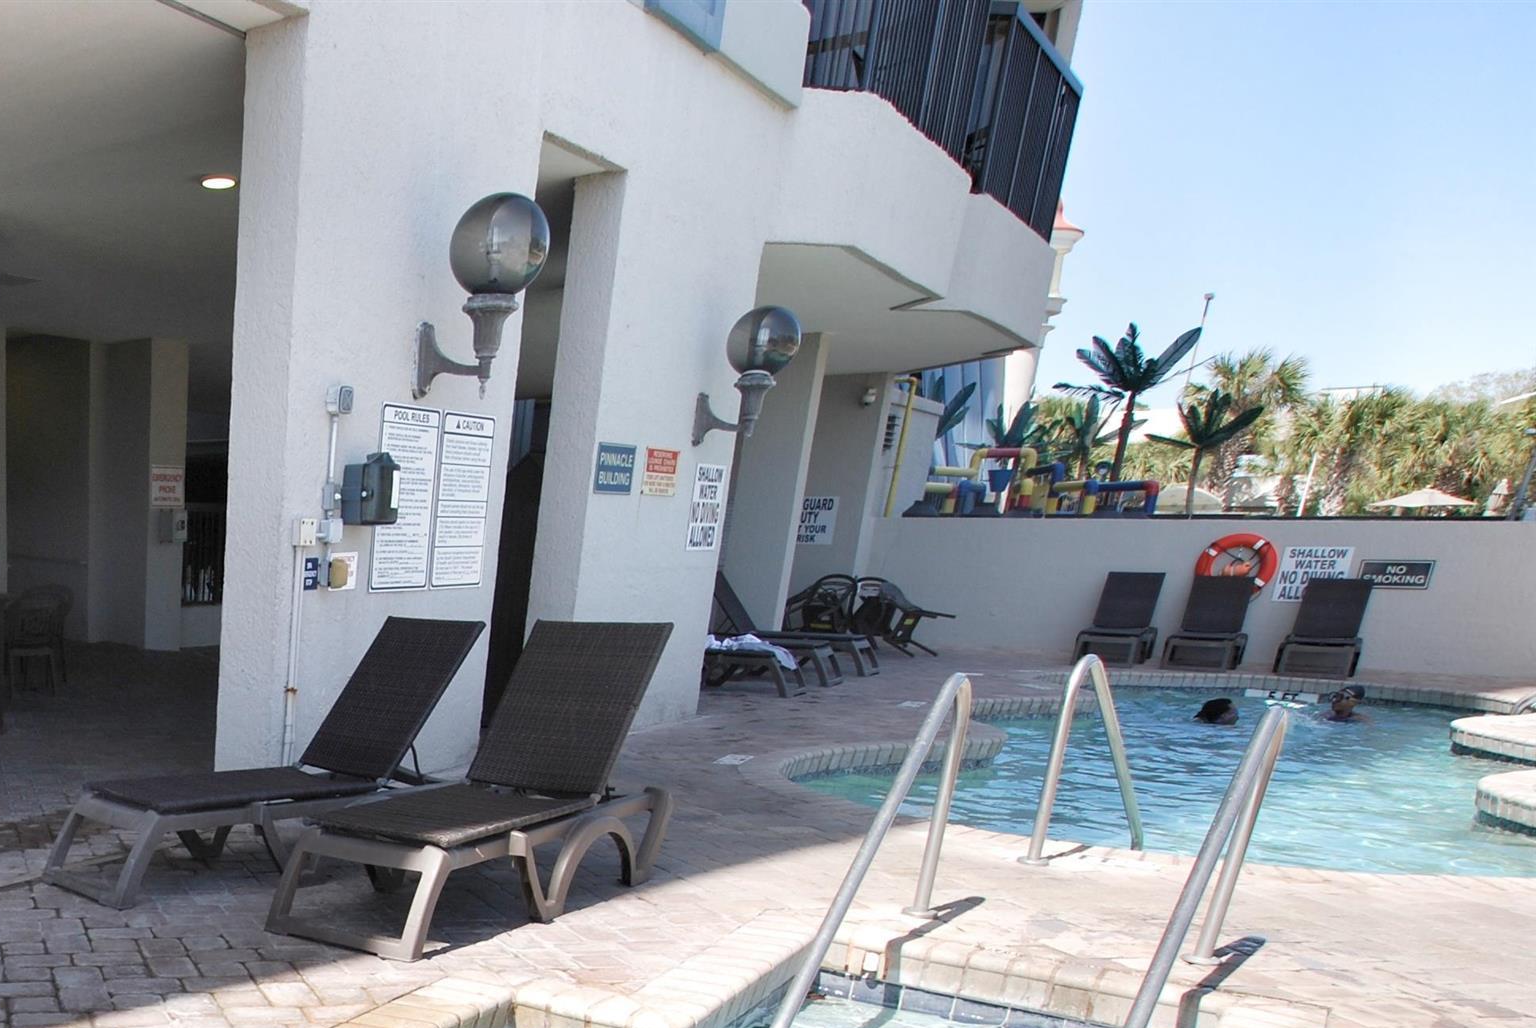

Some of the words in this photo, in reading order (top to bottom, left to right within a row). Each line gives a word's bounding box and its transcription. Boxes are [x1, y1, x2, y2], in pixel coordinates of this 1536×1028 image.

[394, 410, 410, 422] POOL
[411, 411, 431, 424] RULES
[462, 420, 485, 432] CAUTION
[600, 452, 633, 468] PINNACLE
[598, 471, 630, 486] BUILDING
[698, 466, 724, 483] SHALLOW
[699, 484, 718, 500] WATER
[802, 498, 834, 511] GUARD
[691, 502, 700, 524] NO
[700, 502, 720, 524] DIVING
[800, 511, 819, 523] UTY
[688, 525, 716, 547] ALLOWED
[804, 525, 827, 534] YOUR
[797, 535, 816, 543] RISK
[1288, 548, 1348, 559] SHALLOW
[1294, 559, 1337, 570] WATER
[1385, 565, 1407, 575] NO
[1278, 571, 1297, 585] NO
[1277, 585, 1301, 600] ALL
